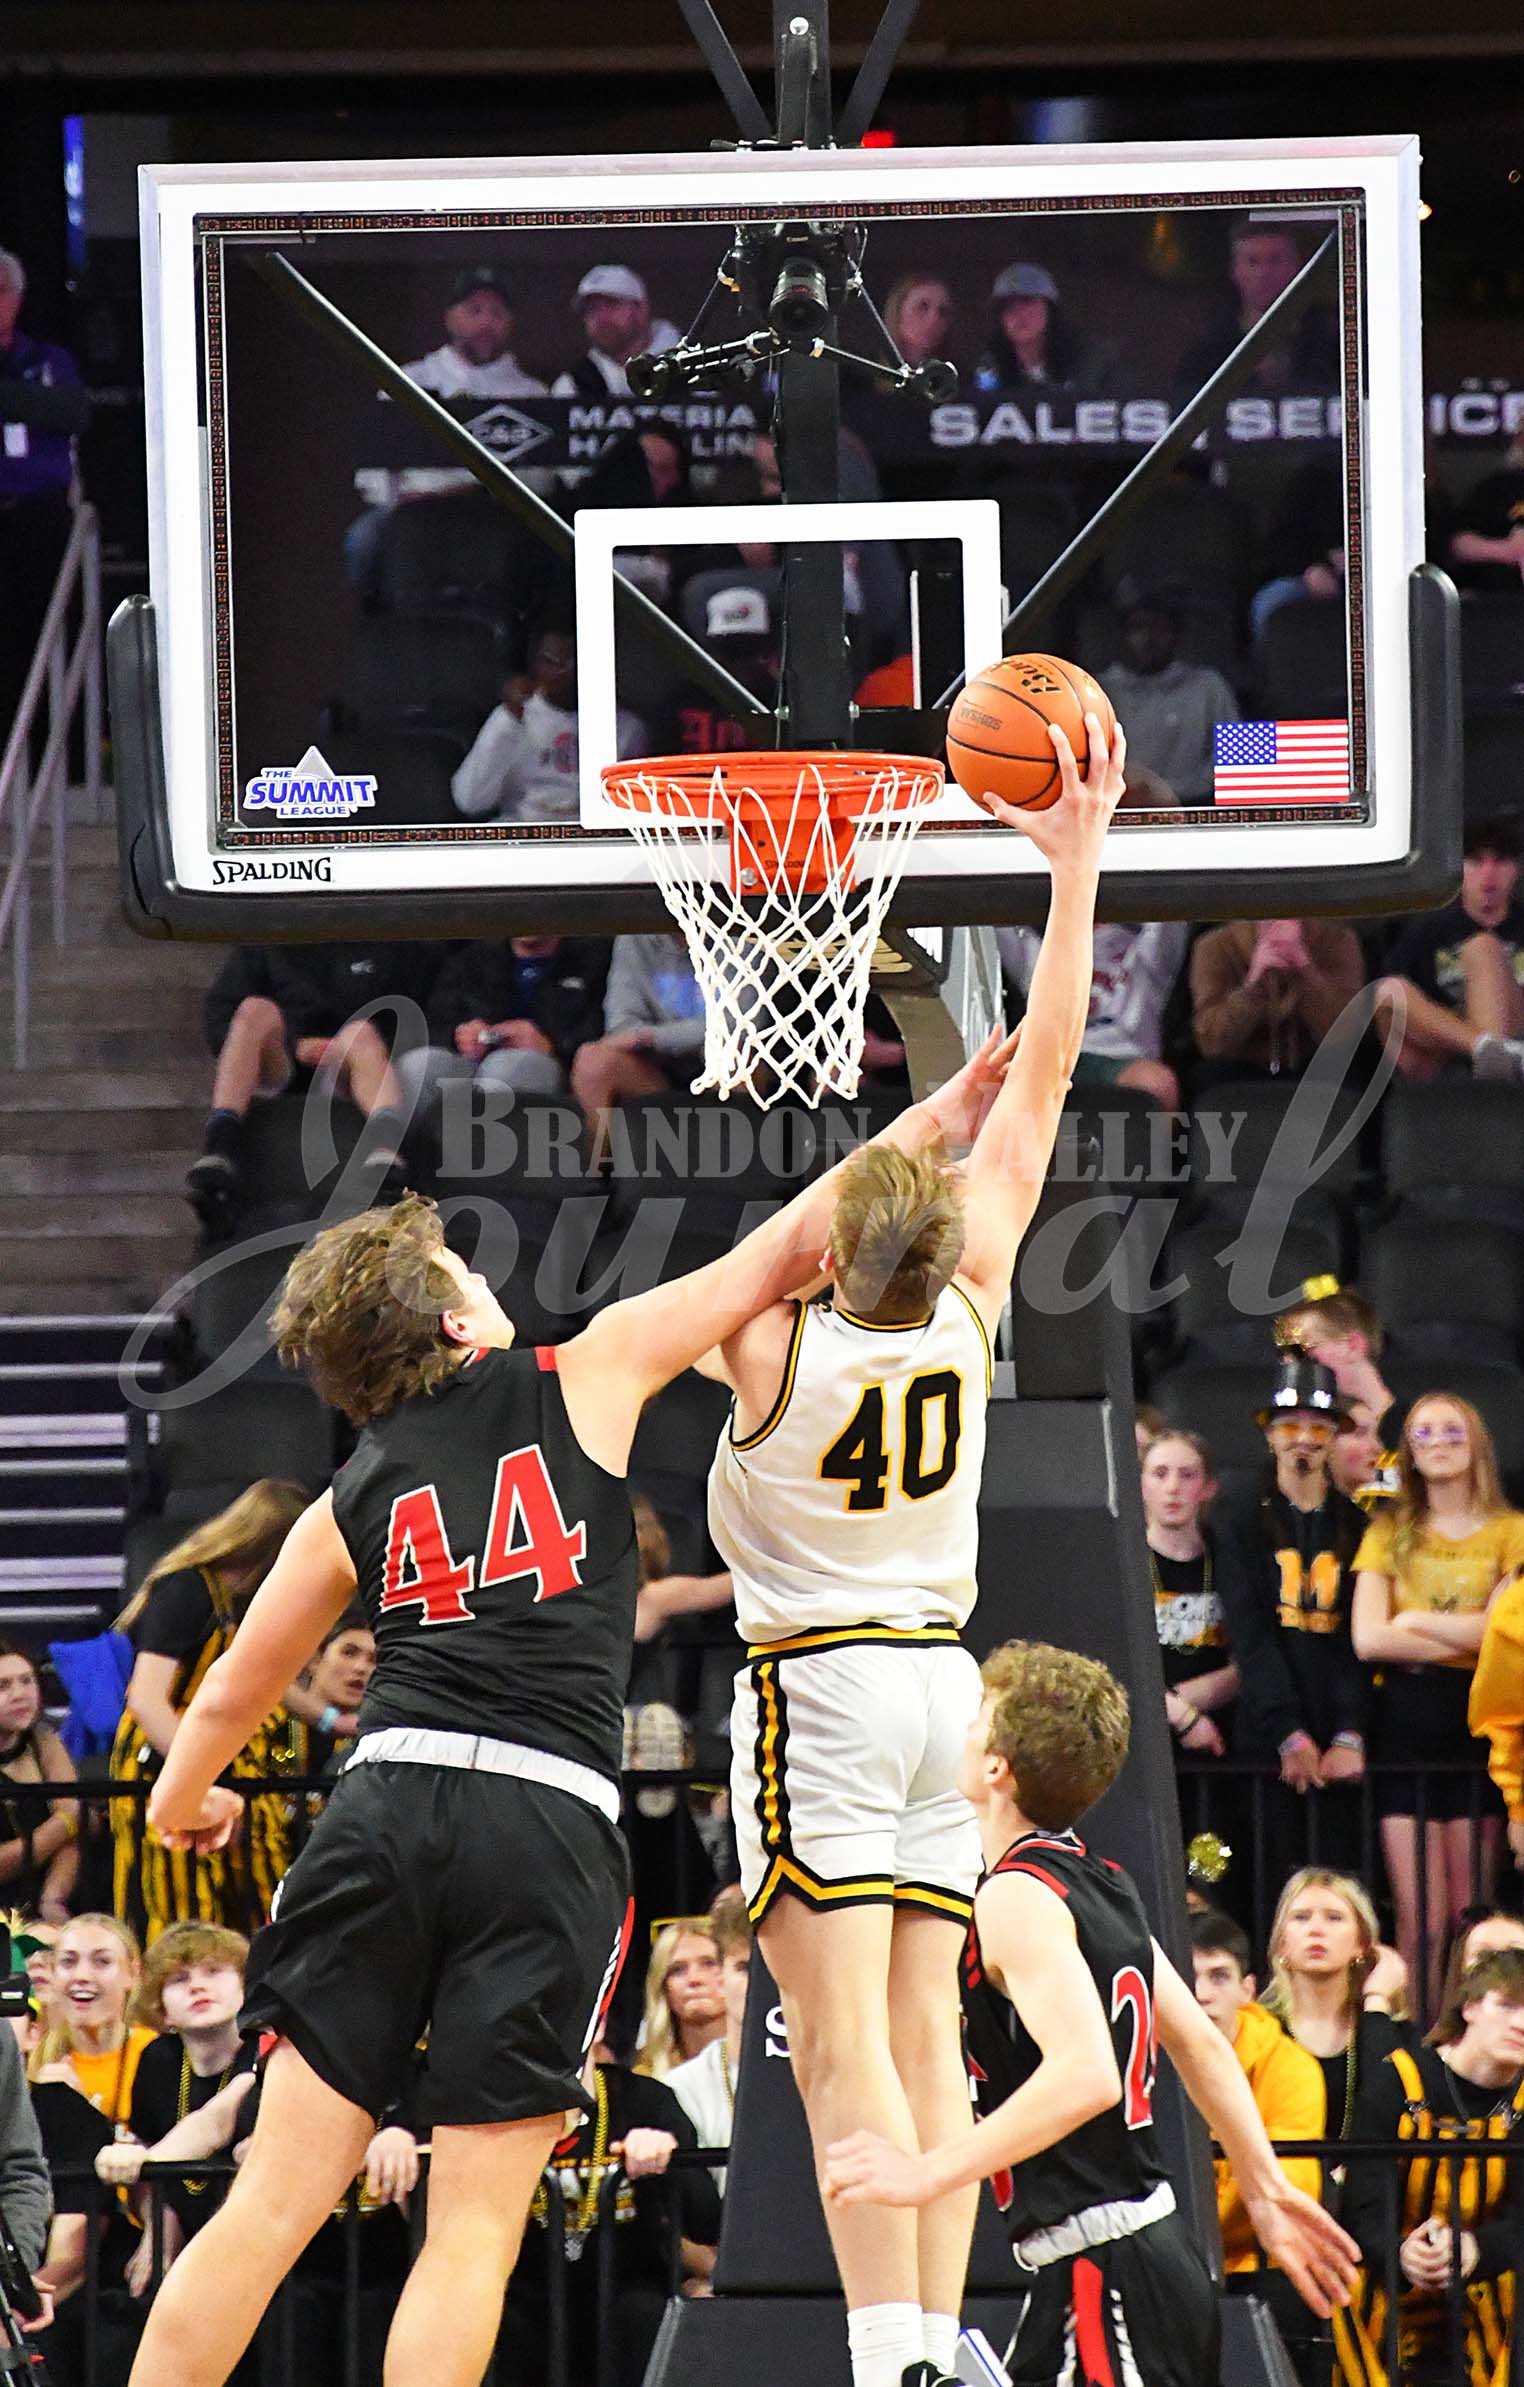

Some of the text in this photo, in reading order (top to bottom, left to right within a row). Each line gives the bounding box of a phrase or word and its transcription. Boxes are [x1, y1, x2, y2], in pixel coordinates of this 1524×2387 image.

[568, 405, 757, 429] MATERIA
[264, 770, 294, 779] THE
[250, 781, 371, 804] SUMMIT
[279, 806, 347, 816] LEAGUE
[213, 857, 331, 885] SPALDING
[816, 1364, 964, 1514] 40
[379, 1443, 587, 1626] 44
